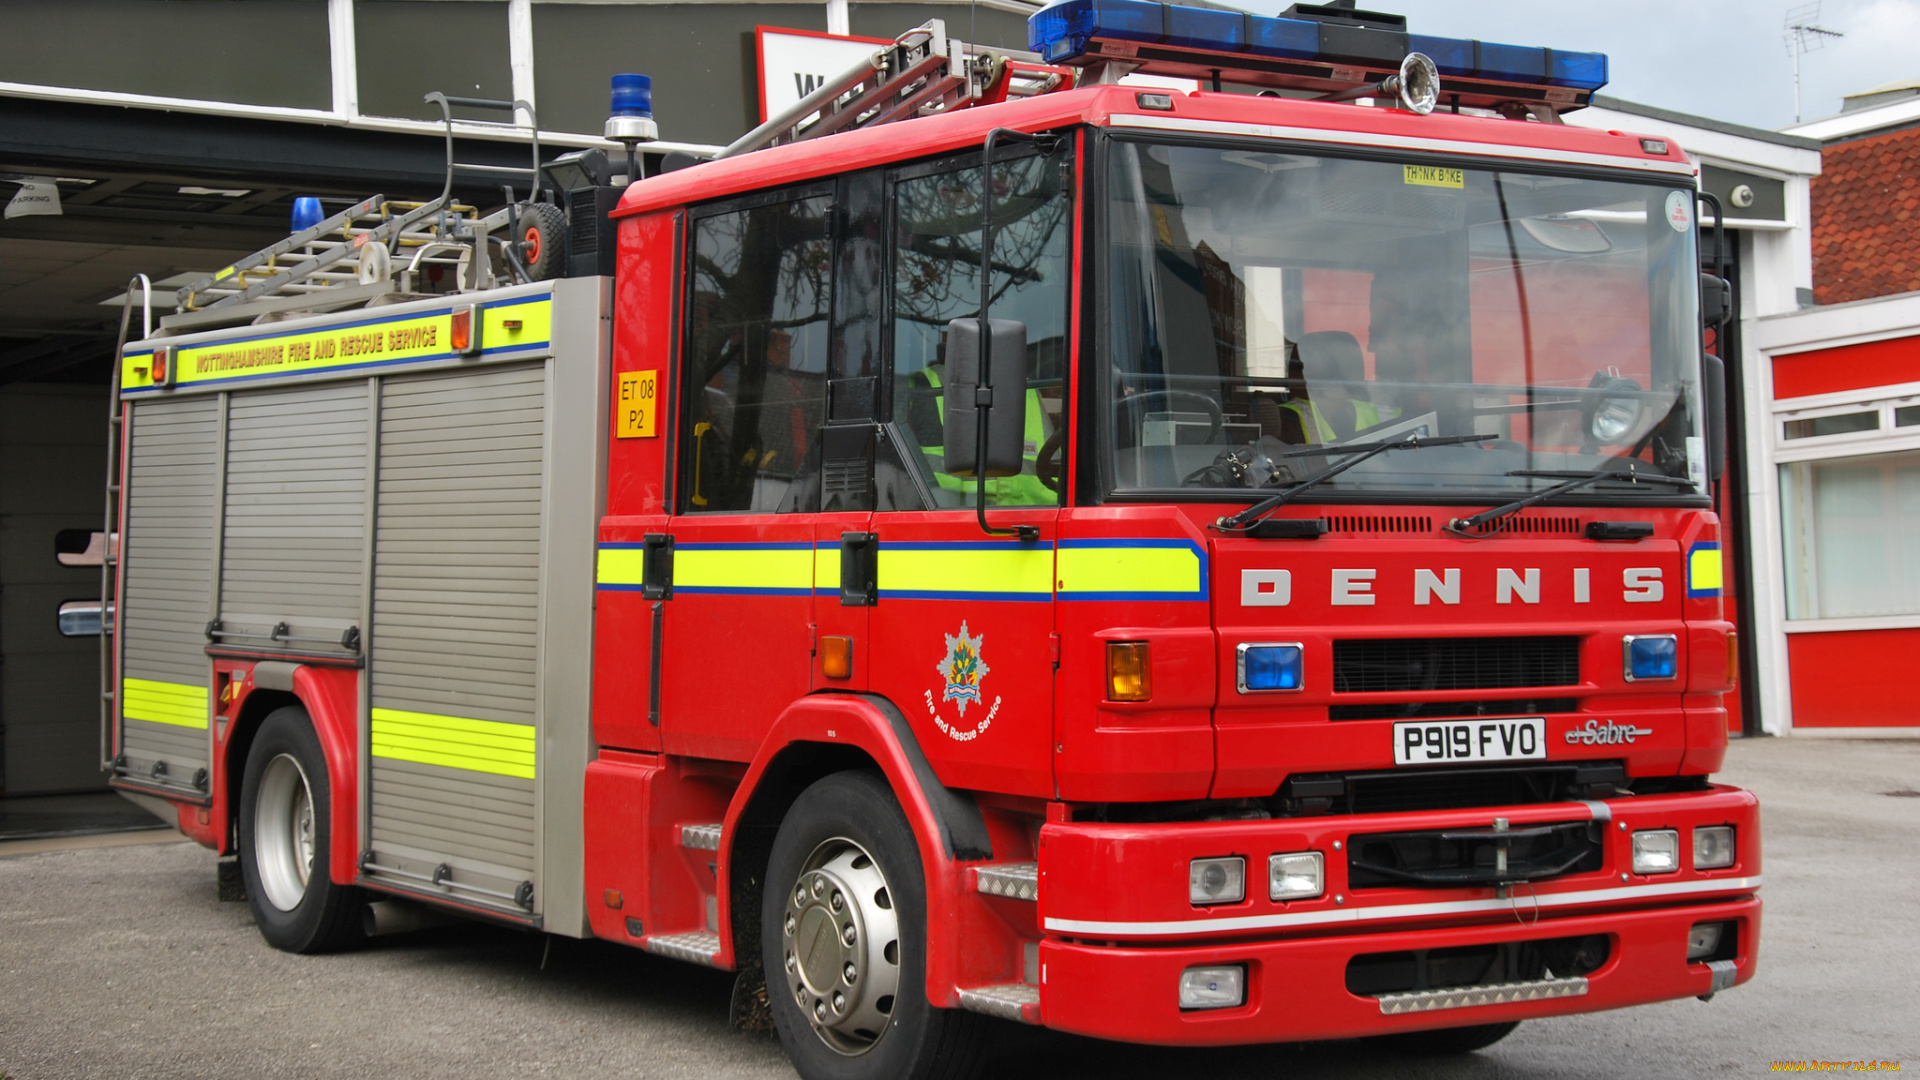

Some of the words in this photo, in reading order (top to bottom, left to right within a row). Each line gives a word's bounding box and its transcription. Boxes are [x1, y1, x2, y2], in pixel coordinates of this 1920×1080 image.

[12, 195, 50, 204] PARKING
[196, 344, 284, 373] NOTTINGHAMSHIRE
[288, 341, 310, 363] FIRE
[314, 339, 336, 360] AND
[340, 332, 383, 357] RESCUE
[388, 325, 437, 351] SERVICE
[622, 380, 637, 400] ET
[640, 379, 654, 399] 08
[629, 409, 644, 430] P2
[1240, 567, 1665, 606] DENNIS
[924, 689, 935, 714] Fire
[934, 715, 949, 734] and
[949, 726, 977, 741] Rescue
[978, 695, 1002, 733] Service
[1404, 725, 1471, 760] P919
[1479, 723, 1536, 757] FVO
[1581, 719, 1638, 746] Sabre
